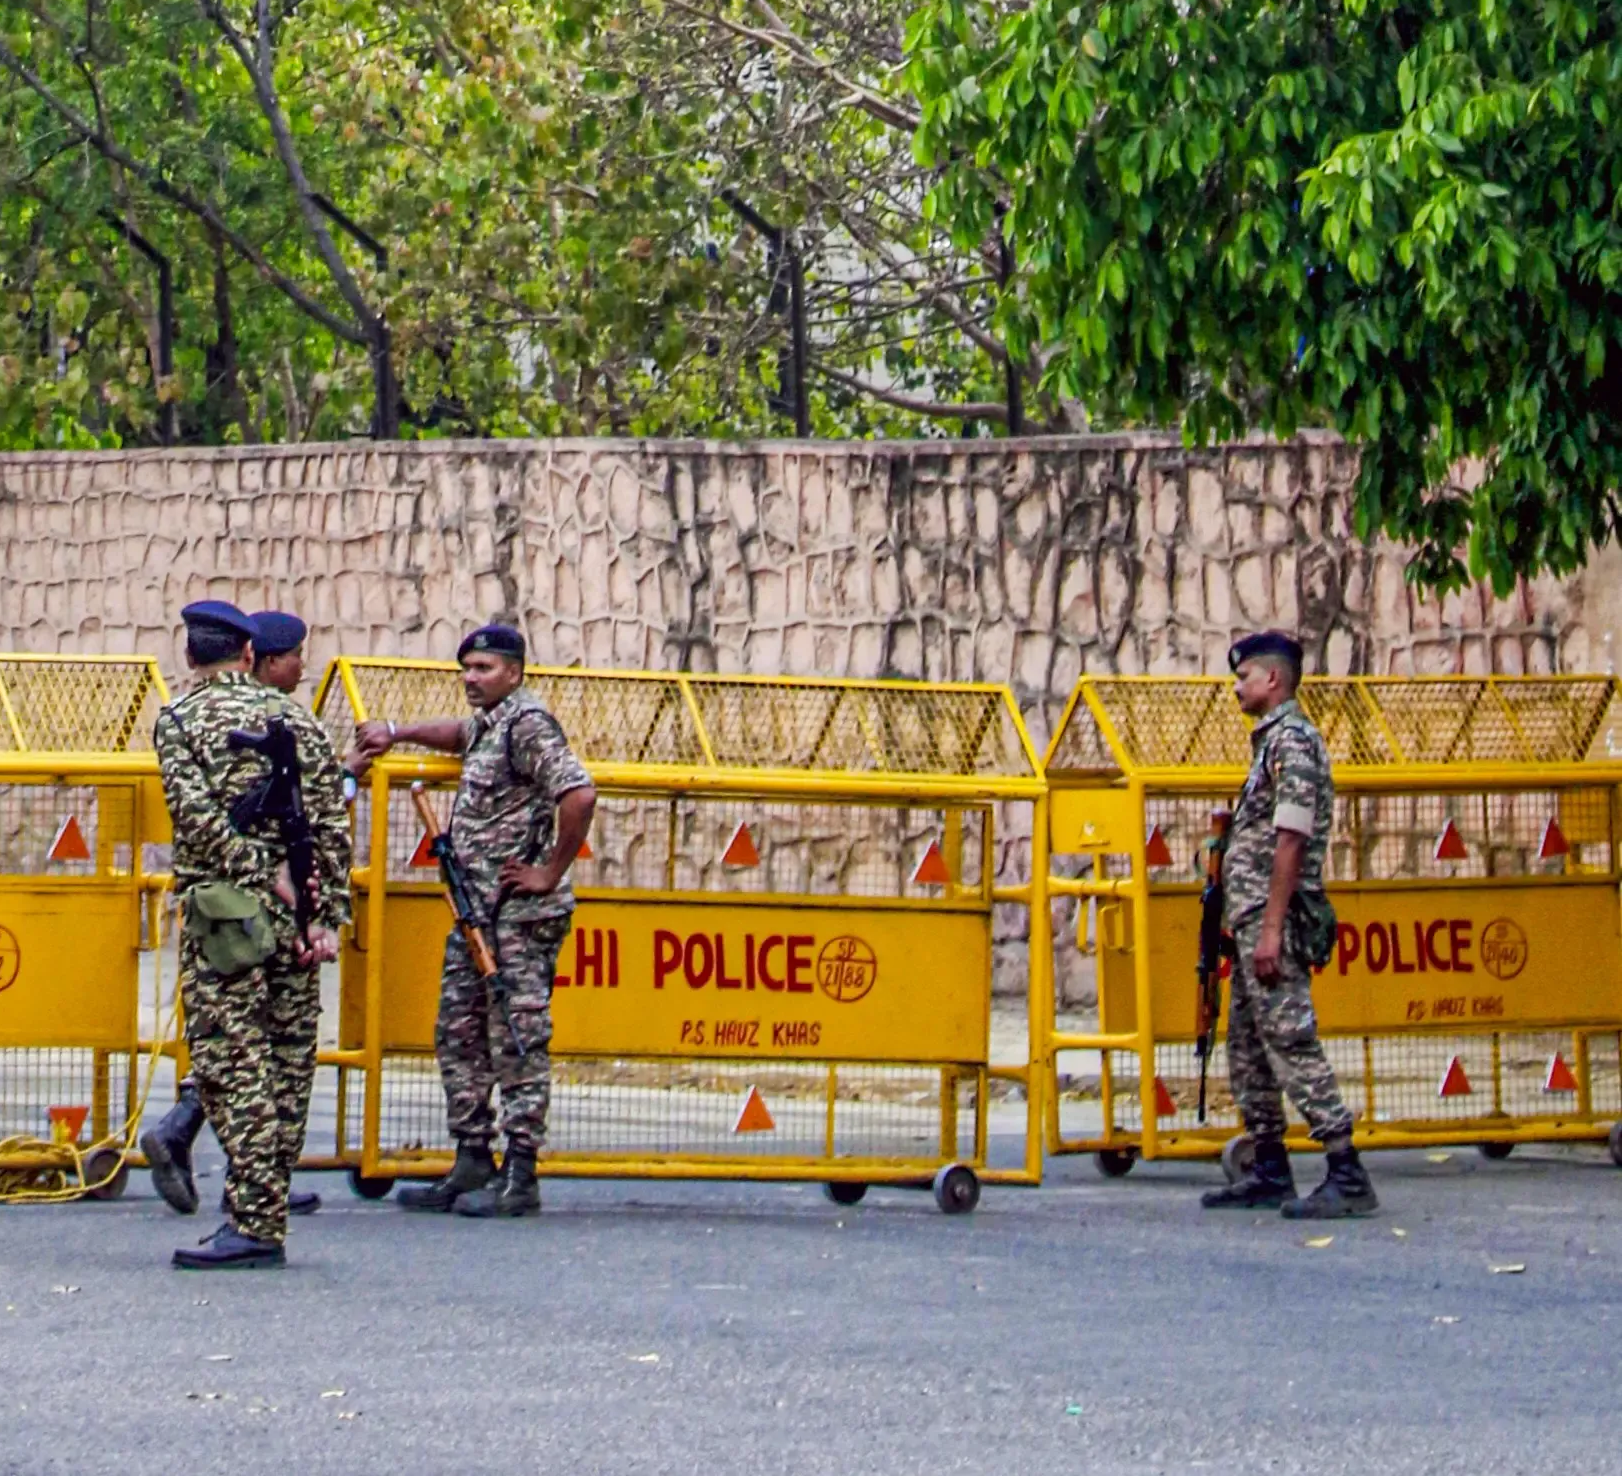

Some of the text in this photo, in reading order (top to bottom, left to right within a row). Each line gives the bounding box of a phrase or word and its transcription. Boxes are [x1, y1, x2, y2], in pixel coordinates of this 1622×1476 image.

[653, 929, 816, 993] POLICE
[1336, 919, 1475, 977] POLICE
[772, 1021, 822, 1048] KHAS
